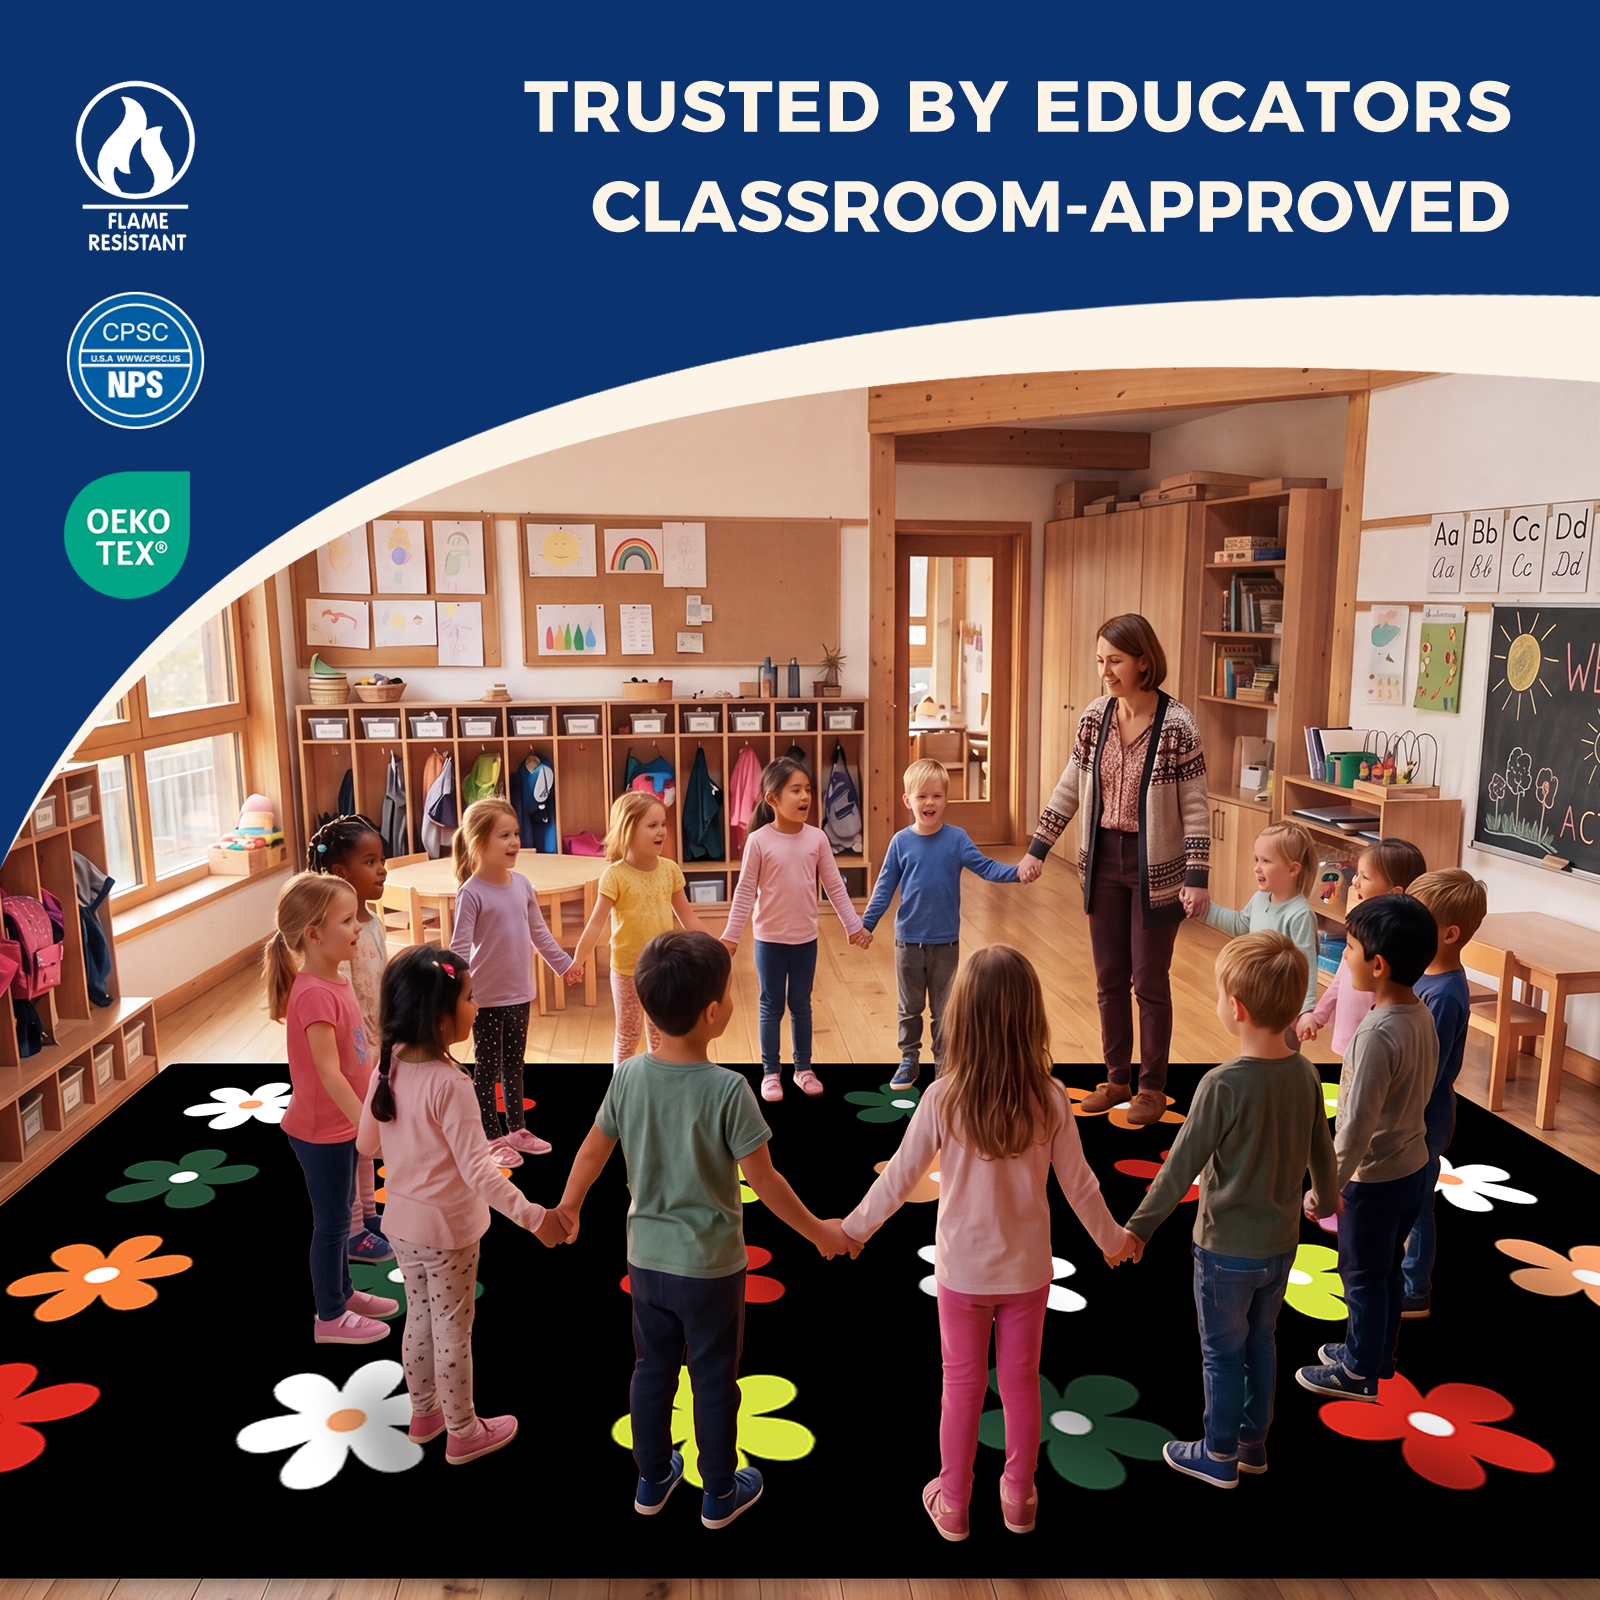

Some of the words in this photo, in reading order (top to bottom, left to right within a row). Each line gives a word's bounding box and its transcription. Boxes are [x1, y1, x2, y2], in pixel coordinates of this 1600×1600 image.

[1434, 521, 1459, 546] Aa
[1472, 516, 1498, 545] Bb
[1512, 515, 1541, 542] Cc
[1555, 507, 1589, 540] Dd
[1431, 556, 1456, 580] Aa
[1469, 554, 1494, 579] Bb
[1511, 553, 1533, 578] Cc
[1551, 550, 1584, 577] Dd
[1559, 805, 1600, 845] AC
